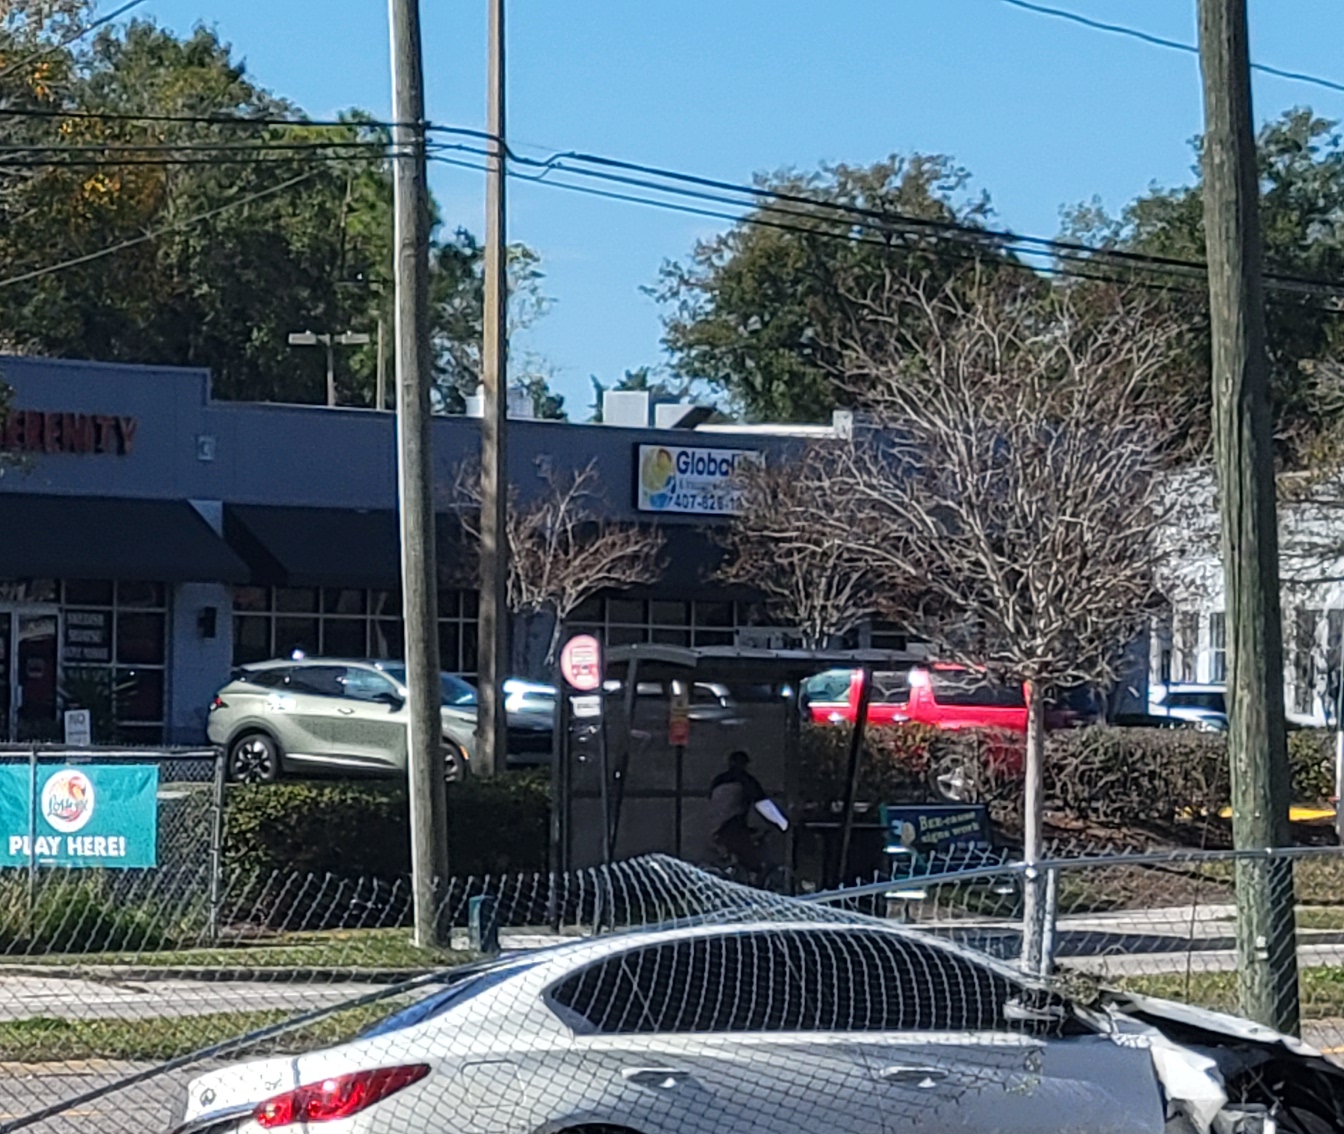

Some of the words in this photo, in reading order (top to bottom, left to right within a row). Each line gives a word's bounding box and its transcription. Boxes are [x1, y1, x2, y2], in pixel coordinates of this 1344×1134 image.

[0, 410, 137, 455] ERENITY
[9, 835, 61, 856] PLAY
[67, 836, 126, 857] HERE!
